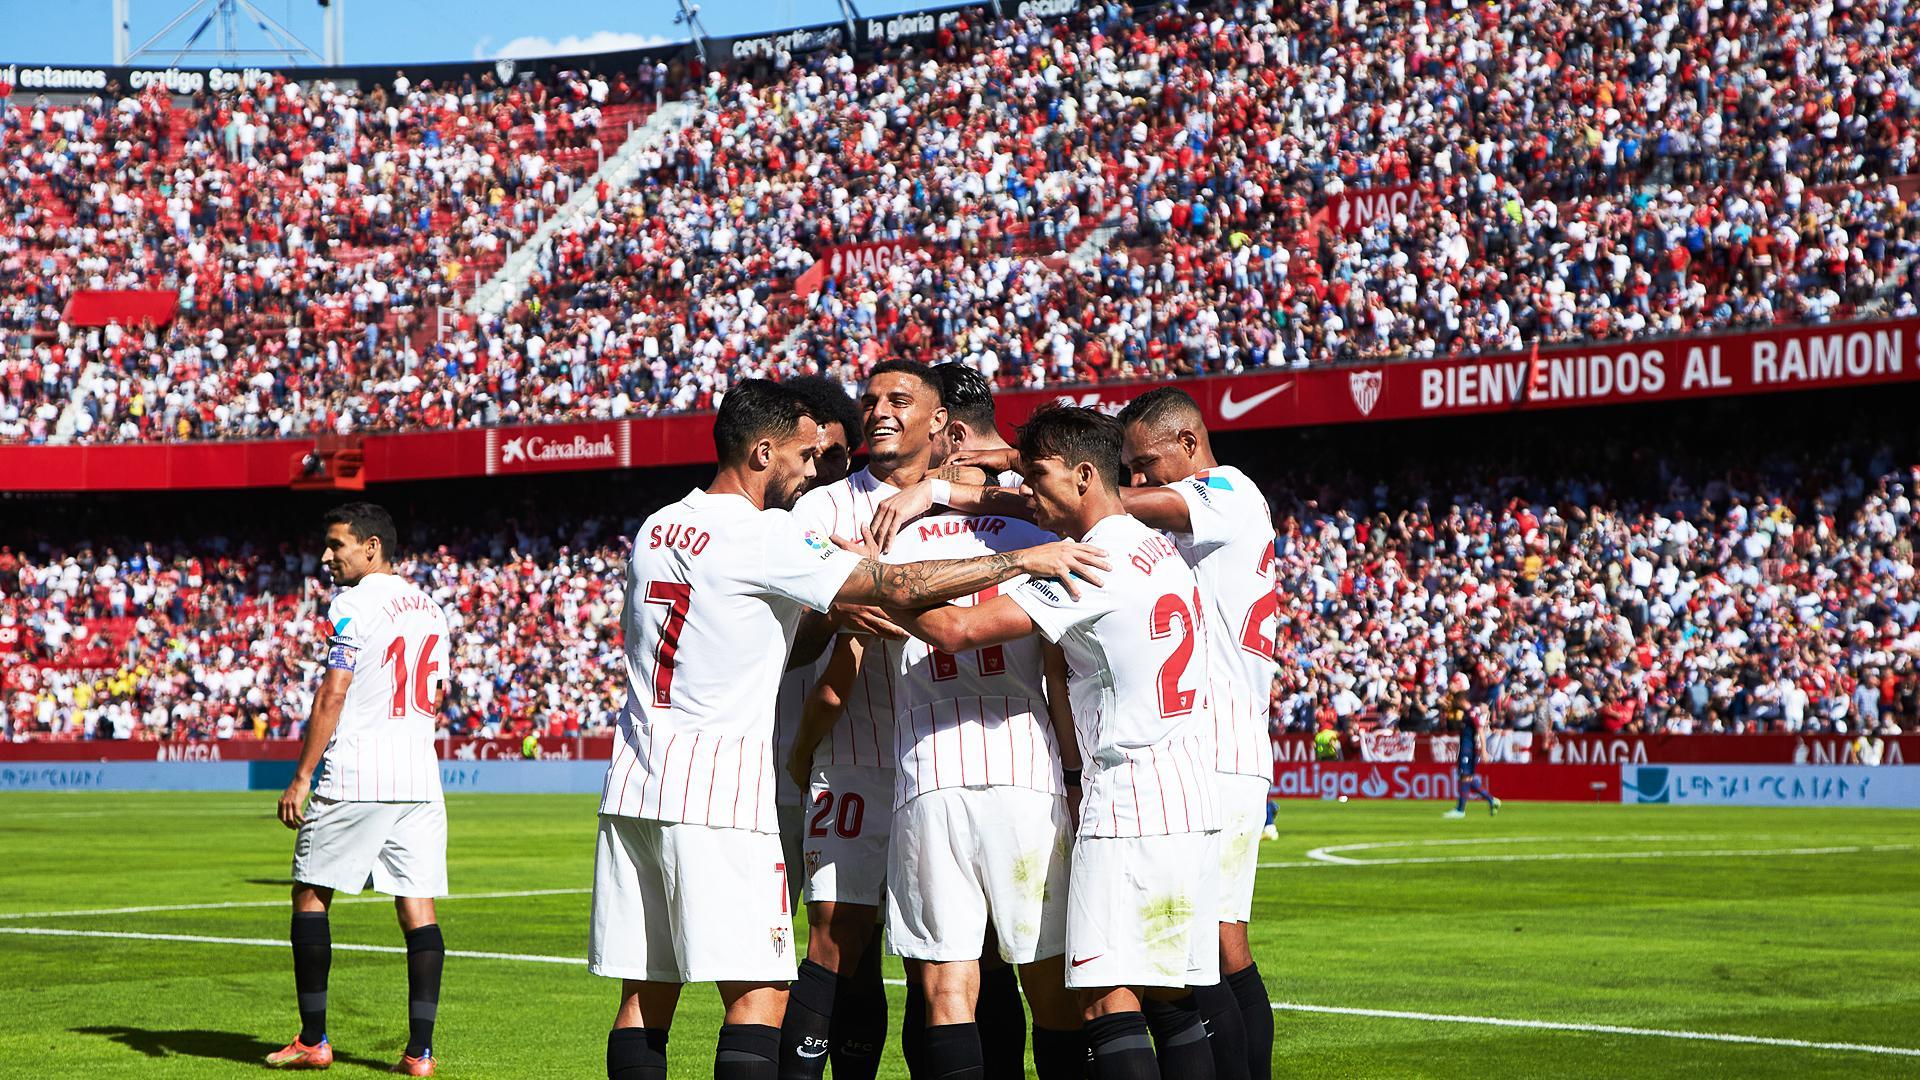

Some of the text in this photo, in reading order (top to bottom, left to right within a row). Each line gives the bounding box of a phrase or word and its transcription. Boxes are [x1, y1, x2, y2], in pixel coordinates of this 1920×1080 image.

[886, 11, 935, 43] gloria
[20, 65, 107, 89] estamos
[1420, 349, 1666, 408] BIENVENIDOS
[1681, 345, 1732, 390] AL
[1752, 328, 1903, 382] RAMON
[526, 433, 615, 461] CaixaBank
[650, 523, 711, 557] SUSO
[918, 517, 1006, 542] MUNIR
[644, 580, 692, 710] 7
[381, 634, 440, 720] 16
[1567, 739, 1649, 765] NAGA
[807, 790, 865, 839] 20
[774, 862, 788, 916] 7
[804, 1036, 829, 1049] SFC
